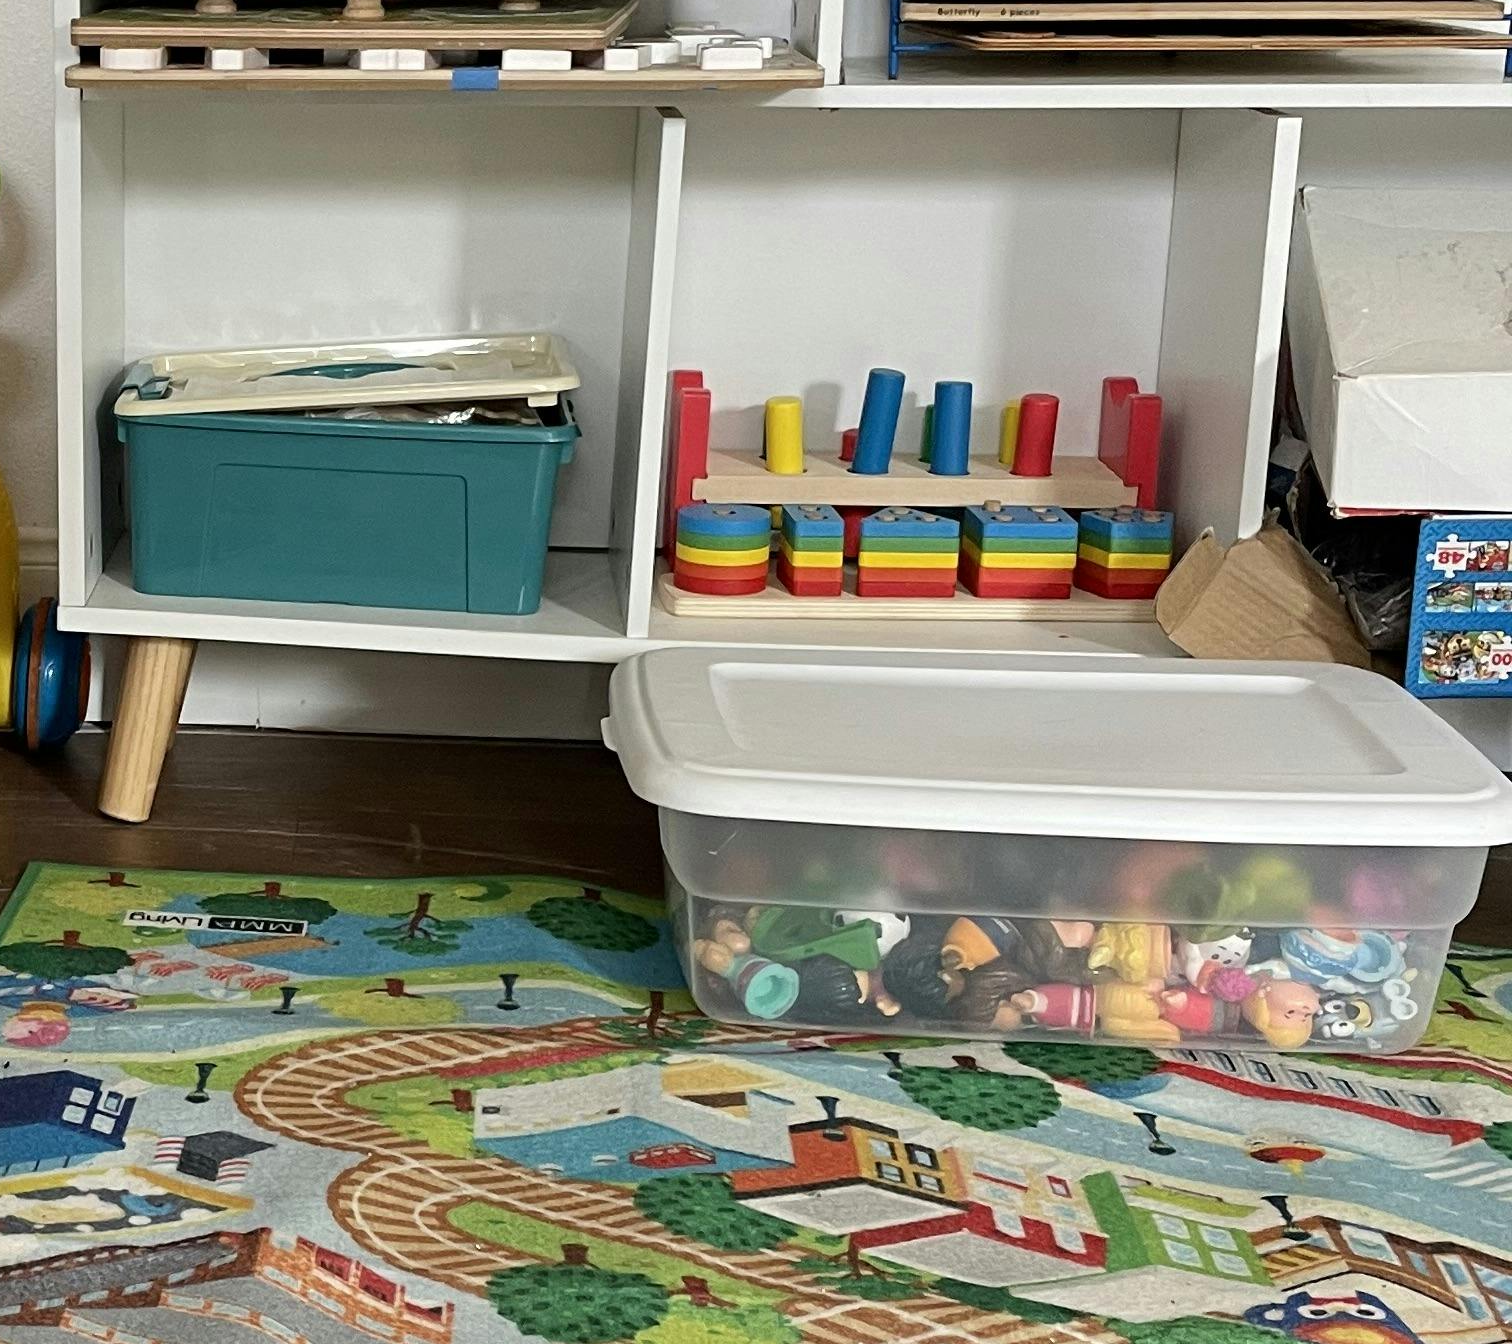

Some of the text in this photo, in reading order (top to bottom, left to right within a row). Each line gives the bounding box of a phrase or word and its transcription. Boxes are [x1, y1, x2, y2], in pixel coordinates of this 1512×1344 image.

[937, 7, 981, 17] Butterfly
[1010, 8, 1040, 17] pieces
[1437, 550, 1466, 565] 48
[128, 911, 203, 927] Living
